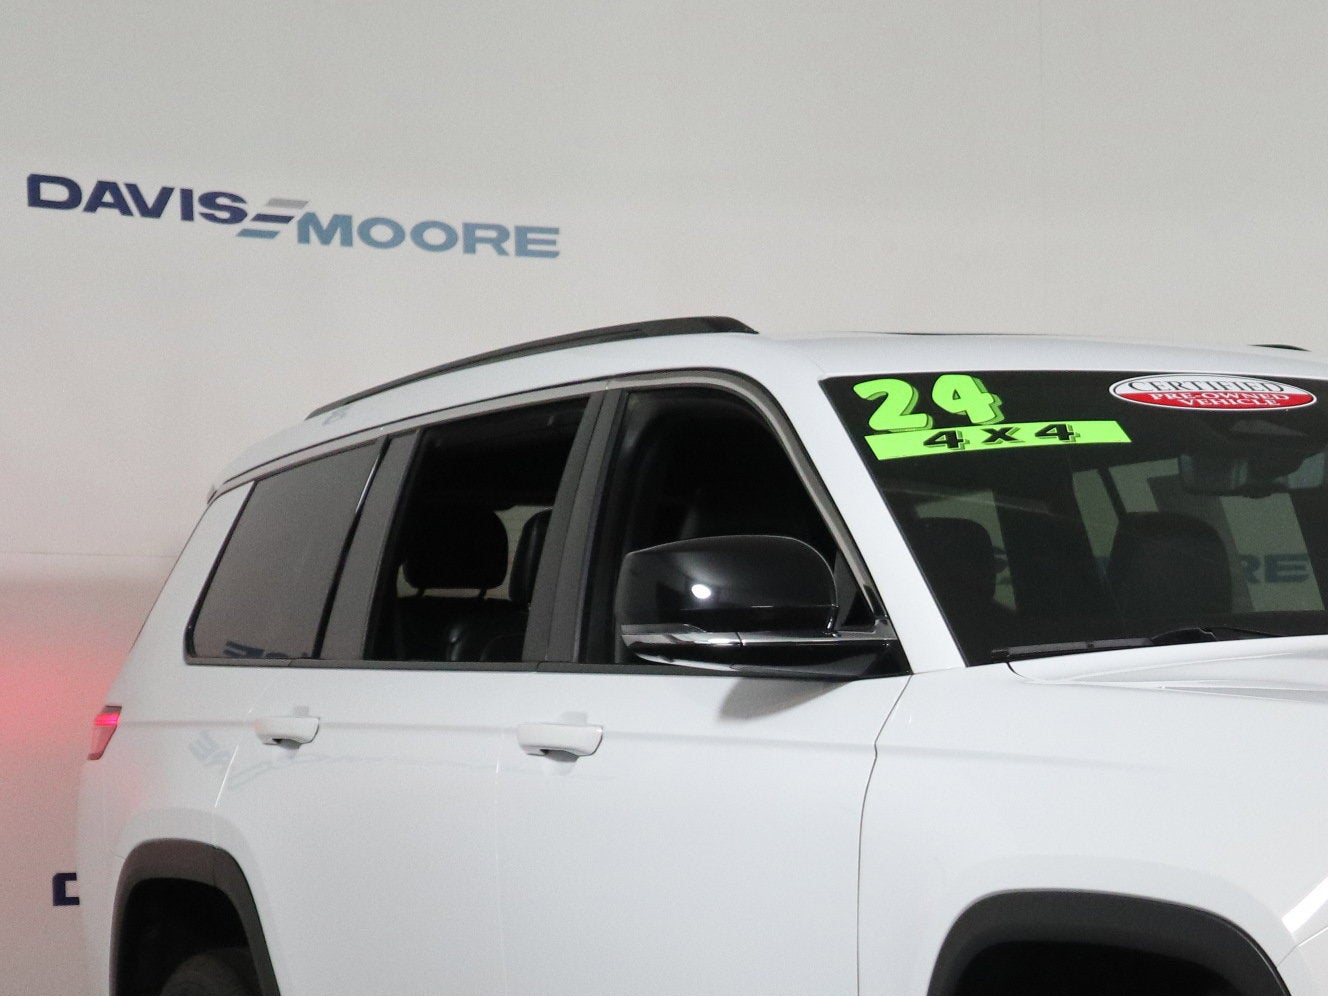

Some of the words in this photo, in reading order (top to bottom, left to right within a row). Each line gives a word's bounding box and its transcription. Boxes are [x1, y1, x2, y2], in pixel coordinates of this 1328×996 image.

[26, 173, 248, 224] DAVIS
[296, 211, 561, 259] MOORE
[853, 374, 1005, 432] 24
[1128, 380, 1284, 392] CERTIFIED
[1149, 392, 1290, 400] PRE-OWNED
